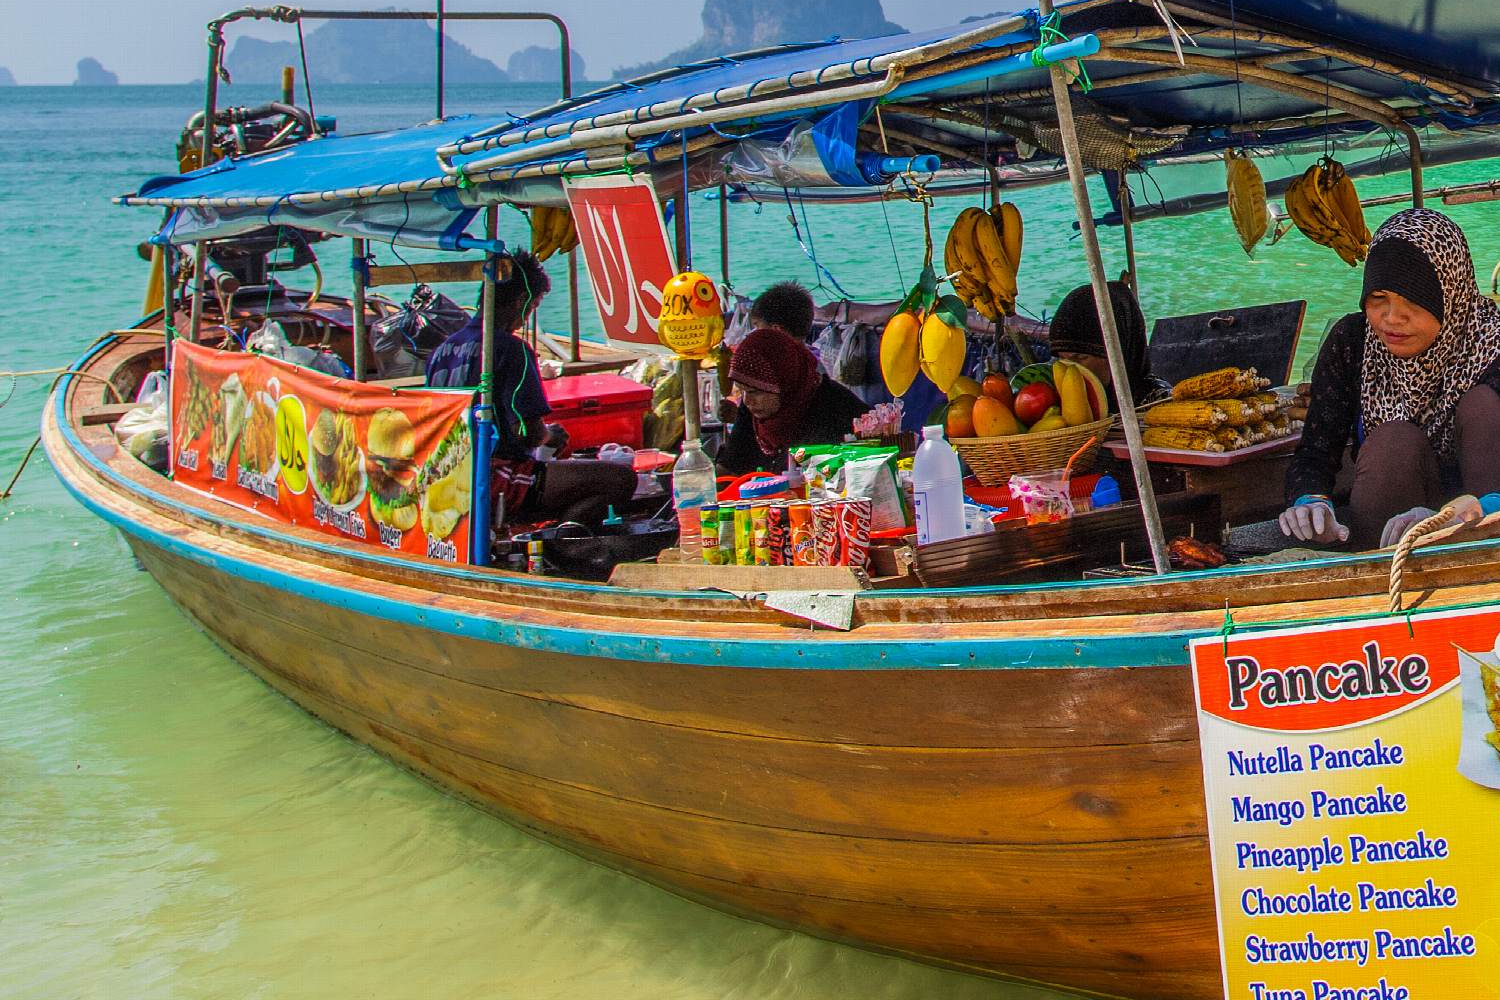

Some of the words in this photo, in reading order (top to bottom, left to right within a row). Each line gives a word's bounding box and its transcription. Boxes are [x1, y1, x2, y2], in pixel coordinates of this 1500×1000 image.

[1226, 642, 1429, 710] Pancake
[1227, 746, 1303, 776] Nutella
[1309, 738, 1404, 771] Pancake
[1232, 795, 1305, 826] Mango
[1311, 786, 1407, 818] Pancake
[1235, 837, 1344, 873] Pineapple
[1349, 832, 1448, 865] Pancake
[1241, 885, 1352, 918] Chocolate
[1358, 879, 1457, 911] Pancake
[1245, 931, 1369, 966] Strawberry
[1375, 927, 1476, 959] Pancake
